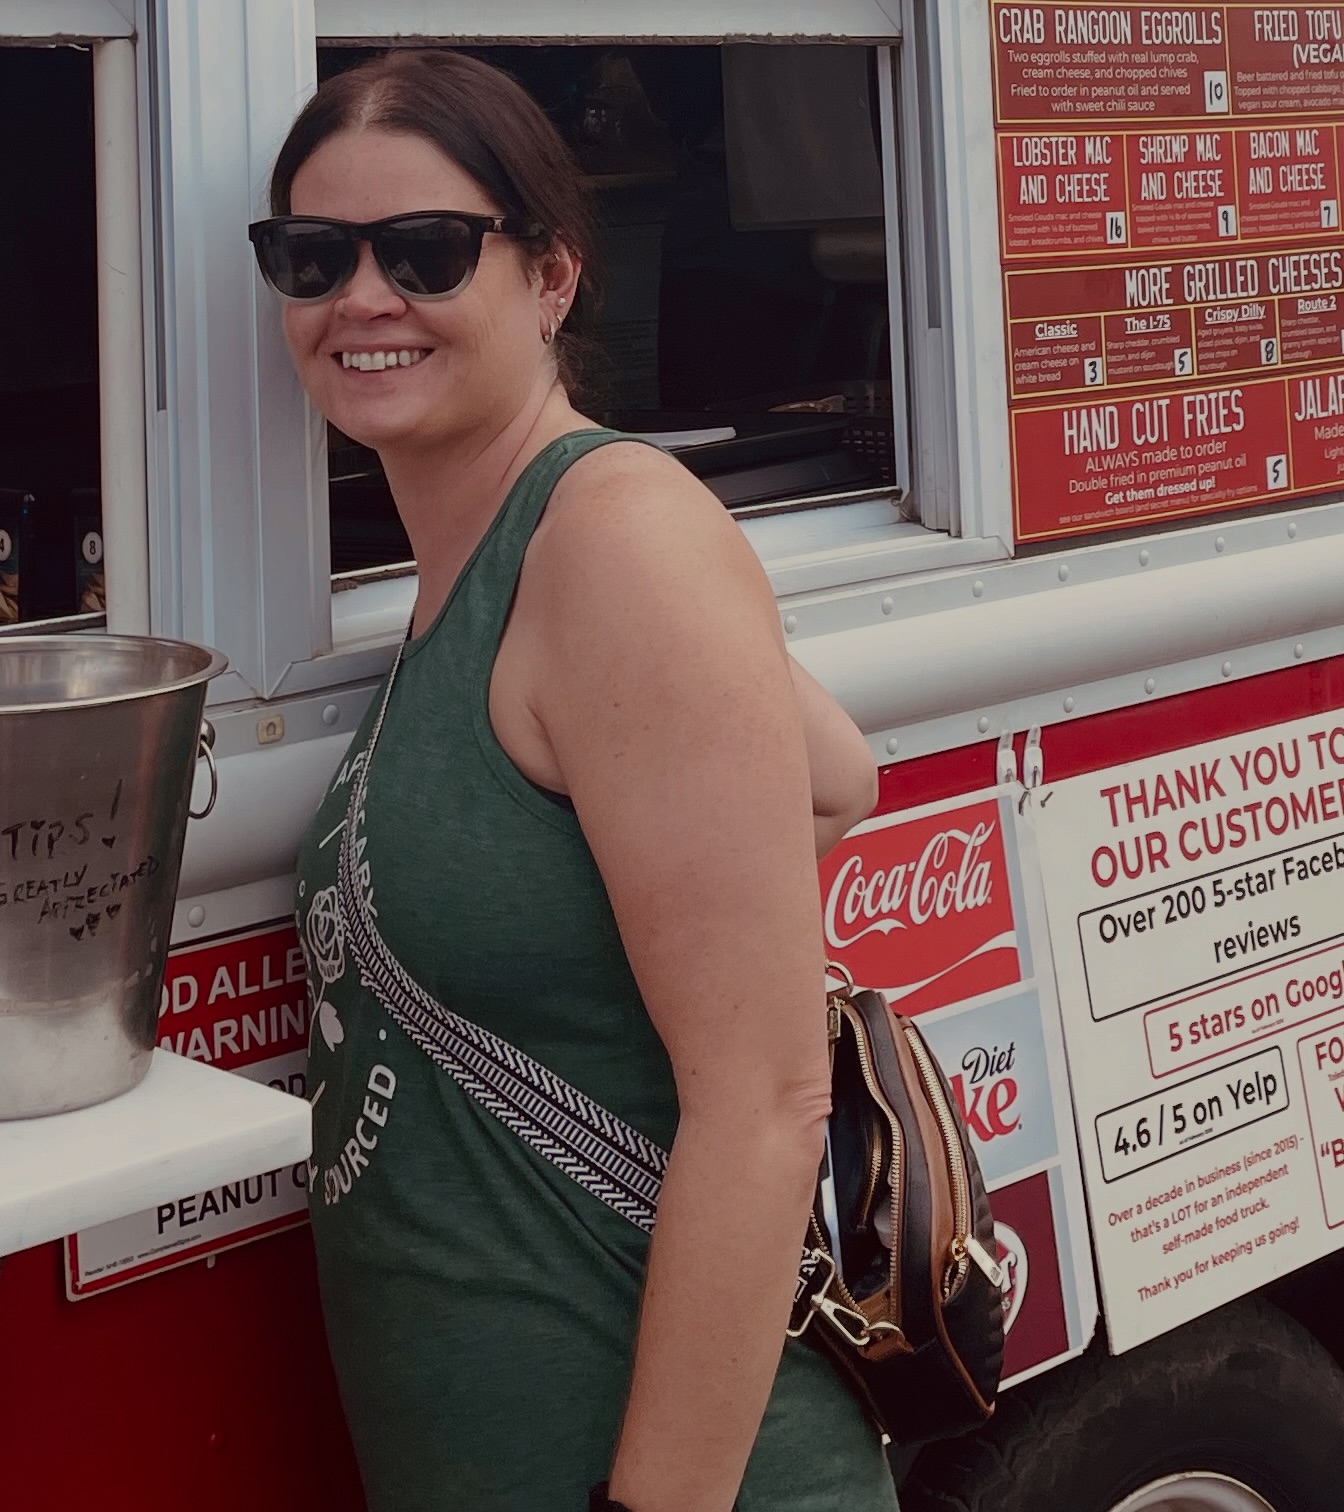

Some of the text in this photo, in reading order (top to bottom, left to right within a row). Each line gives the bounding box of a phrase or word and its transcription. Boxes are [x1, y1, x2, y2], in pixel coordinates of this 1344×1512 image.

[998, 7, 1223, 45] CRAB RANGOON EGGROLLS
[1124, 251, 1343, 309] MORE GRILLED CHEESES
[1204, 302, 1266, 324] Crispy Dilly
[1062, 388, 1245, 456] HAND CUT FRIES
[1104, 475, 1217, 506] Get them dressed up!
[1099, 757, 1228, 828] THANK
[1229, 737, 1302, 792] YOU
[824, 817, 997, 949] Coca-Cola
[1090, 830, 1171, 889] OUR
[1098, 905, 1156, 945] Over
[1160, 885, 1207, 925] 200
[1211, 867, 1277, 909] 5-star
[1213, 914, 1302, 964] reviews
[1168, 1021, 1184, 1053] 5
[1188, 1004, 1247, 1046] stars
[1250, 992, 1281, 1022] on
[962, 1041, 1017, 1085] Diet
[1113, 1070, 1278, 1157] 4.6 / 5 on Yelp
[157, 1164, 283, 1236] PEANUT
